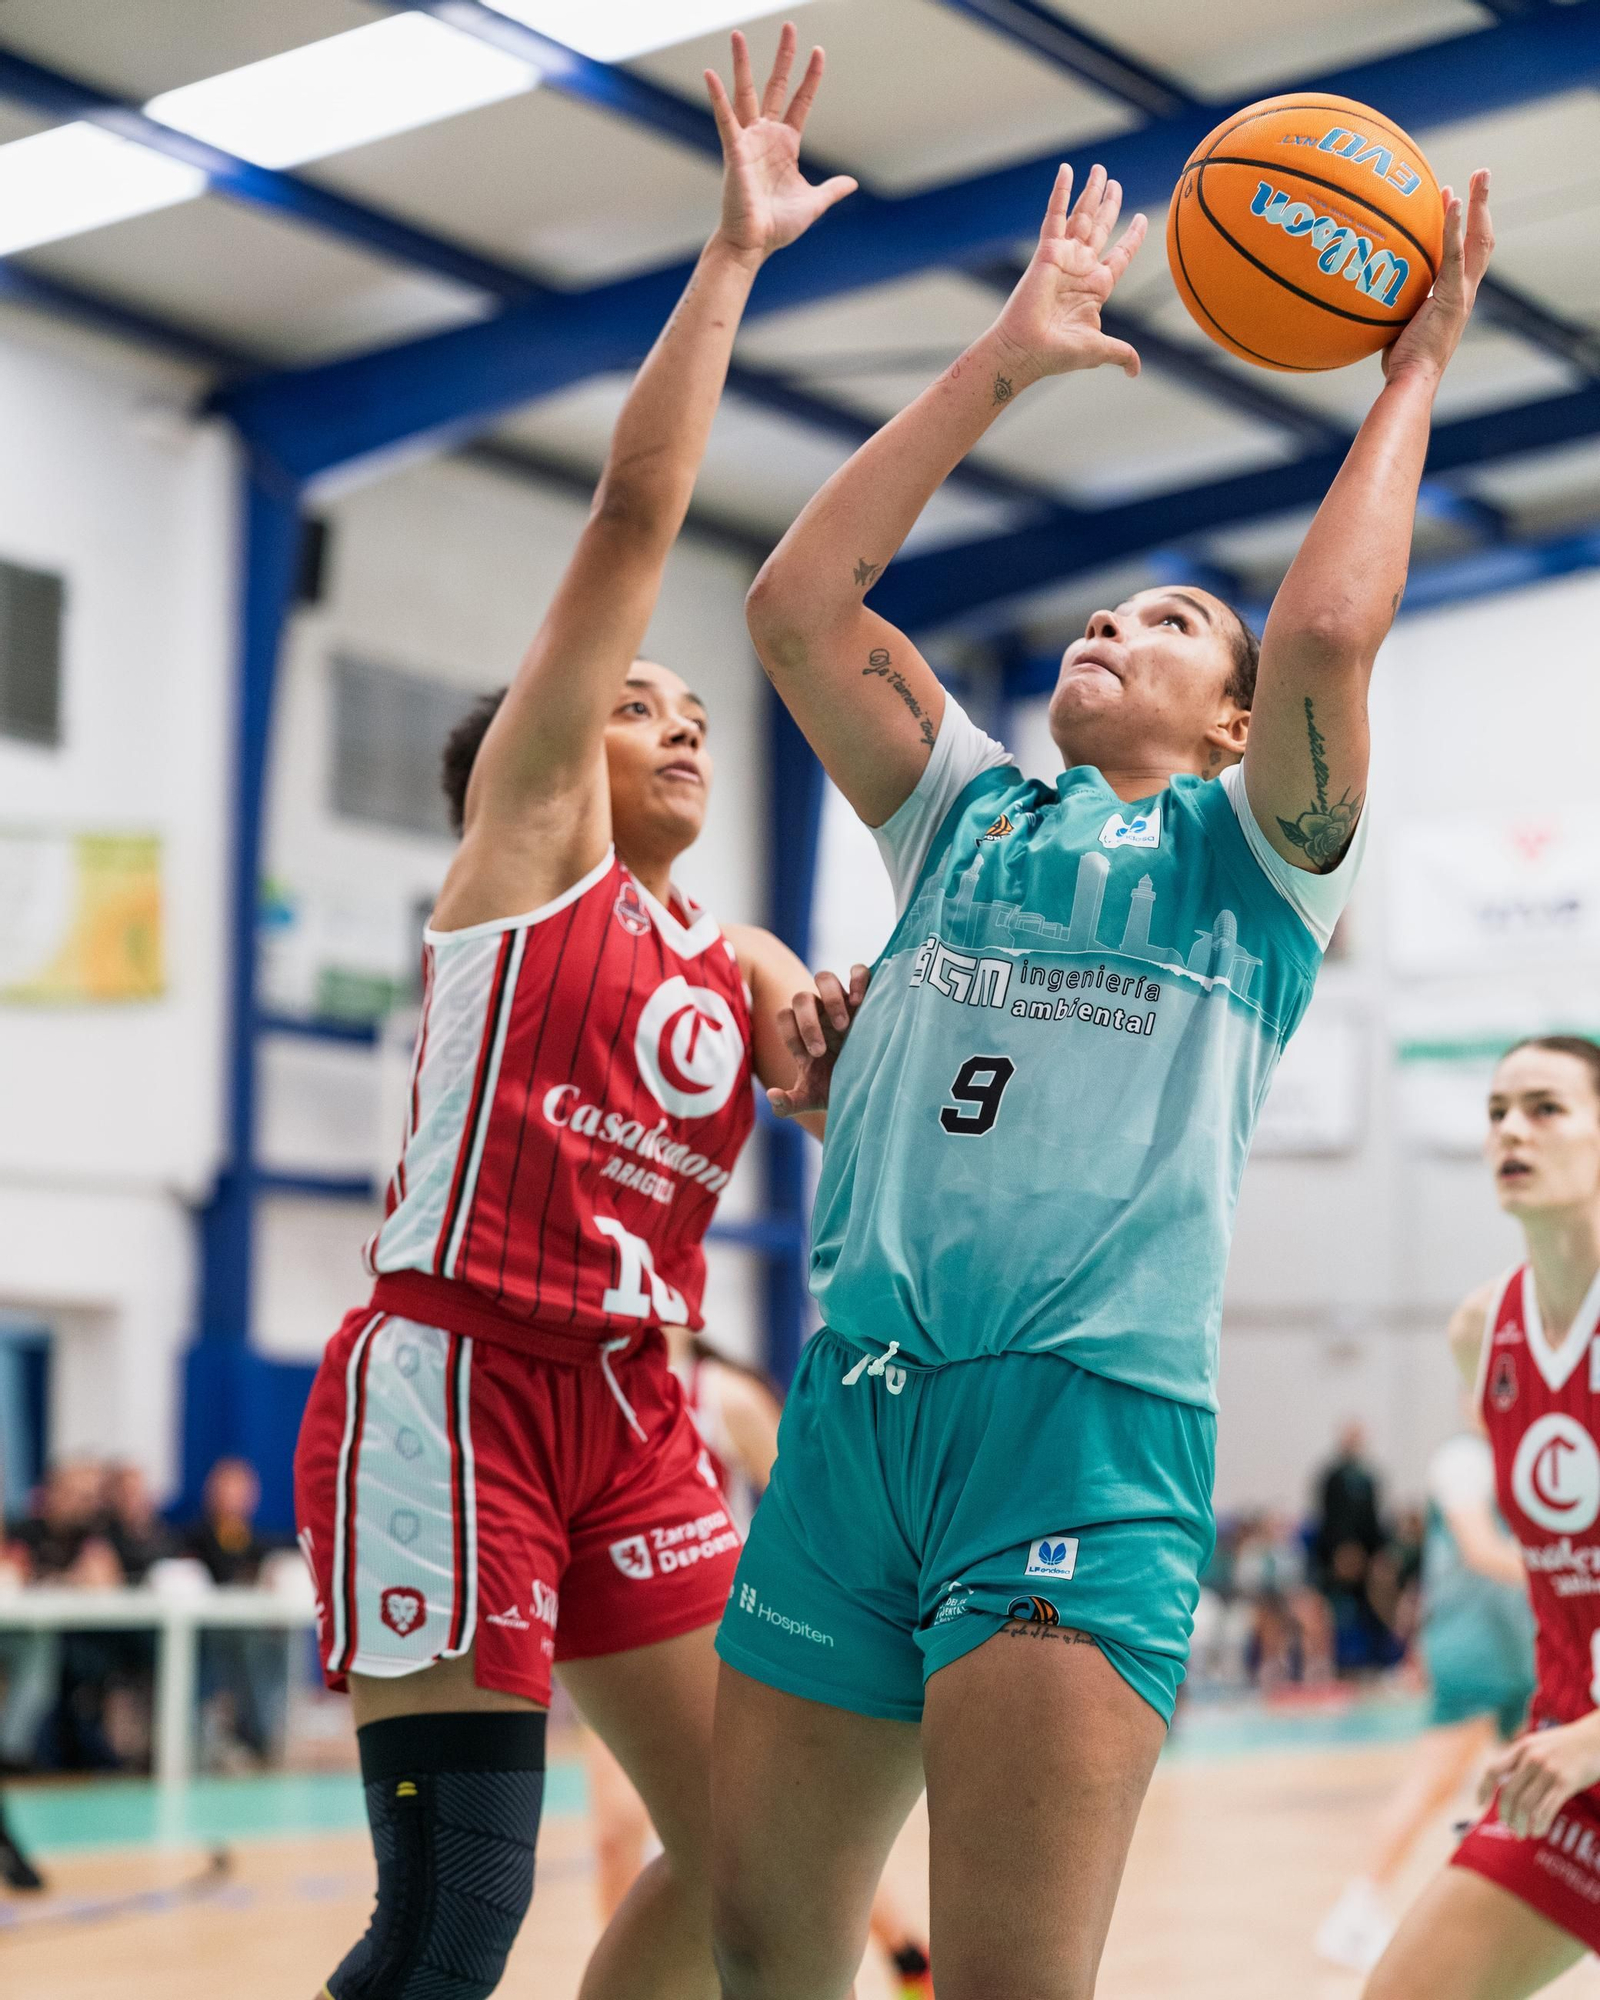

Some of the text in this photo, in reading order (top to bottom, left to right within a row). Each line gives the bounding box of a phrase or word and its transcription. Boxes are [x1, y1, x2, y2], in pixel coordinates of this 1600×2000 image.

[1317, 126, 1422, 197] EVO
[1250, 180, 1410, 308] Wilson
[1020, 959, 1161, 1002] ingeniería
[1011, 997, 1156, 1036] ambiental
[938, 1054, 1018, 1137] 9
[757, 1602, 834, 1648] Hospiten
